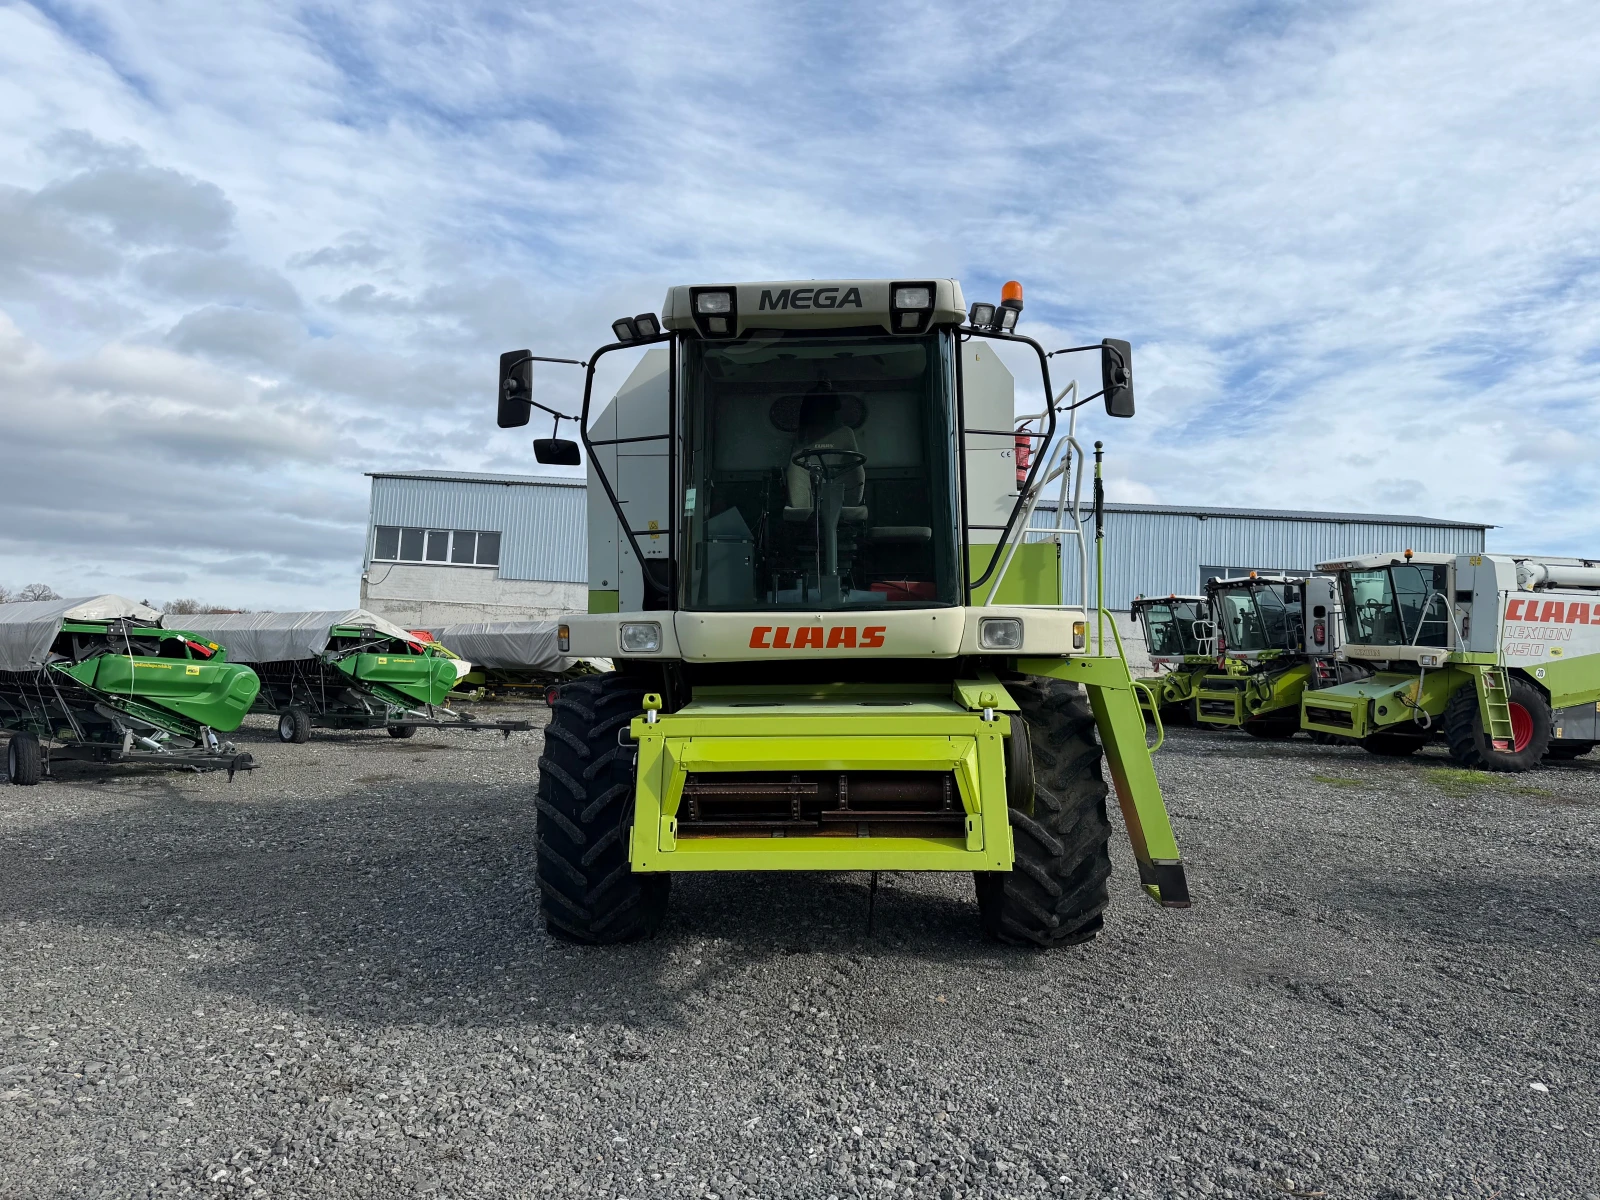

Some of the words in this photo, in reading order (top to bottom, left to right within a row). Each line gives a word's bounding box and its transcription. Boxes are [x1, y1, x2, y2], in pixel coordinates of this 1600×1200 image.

[758, 287, 863, 311] MEGA
[749, 626, 887, 649] CLAAS
[1503, 625, 1573, 641] LEXION
[1503, 642, 1545, 657] 450
[1536, 669, 1545, 678] 20
